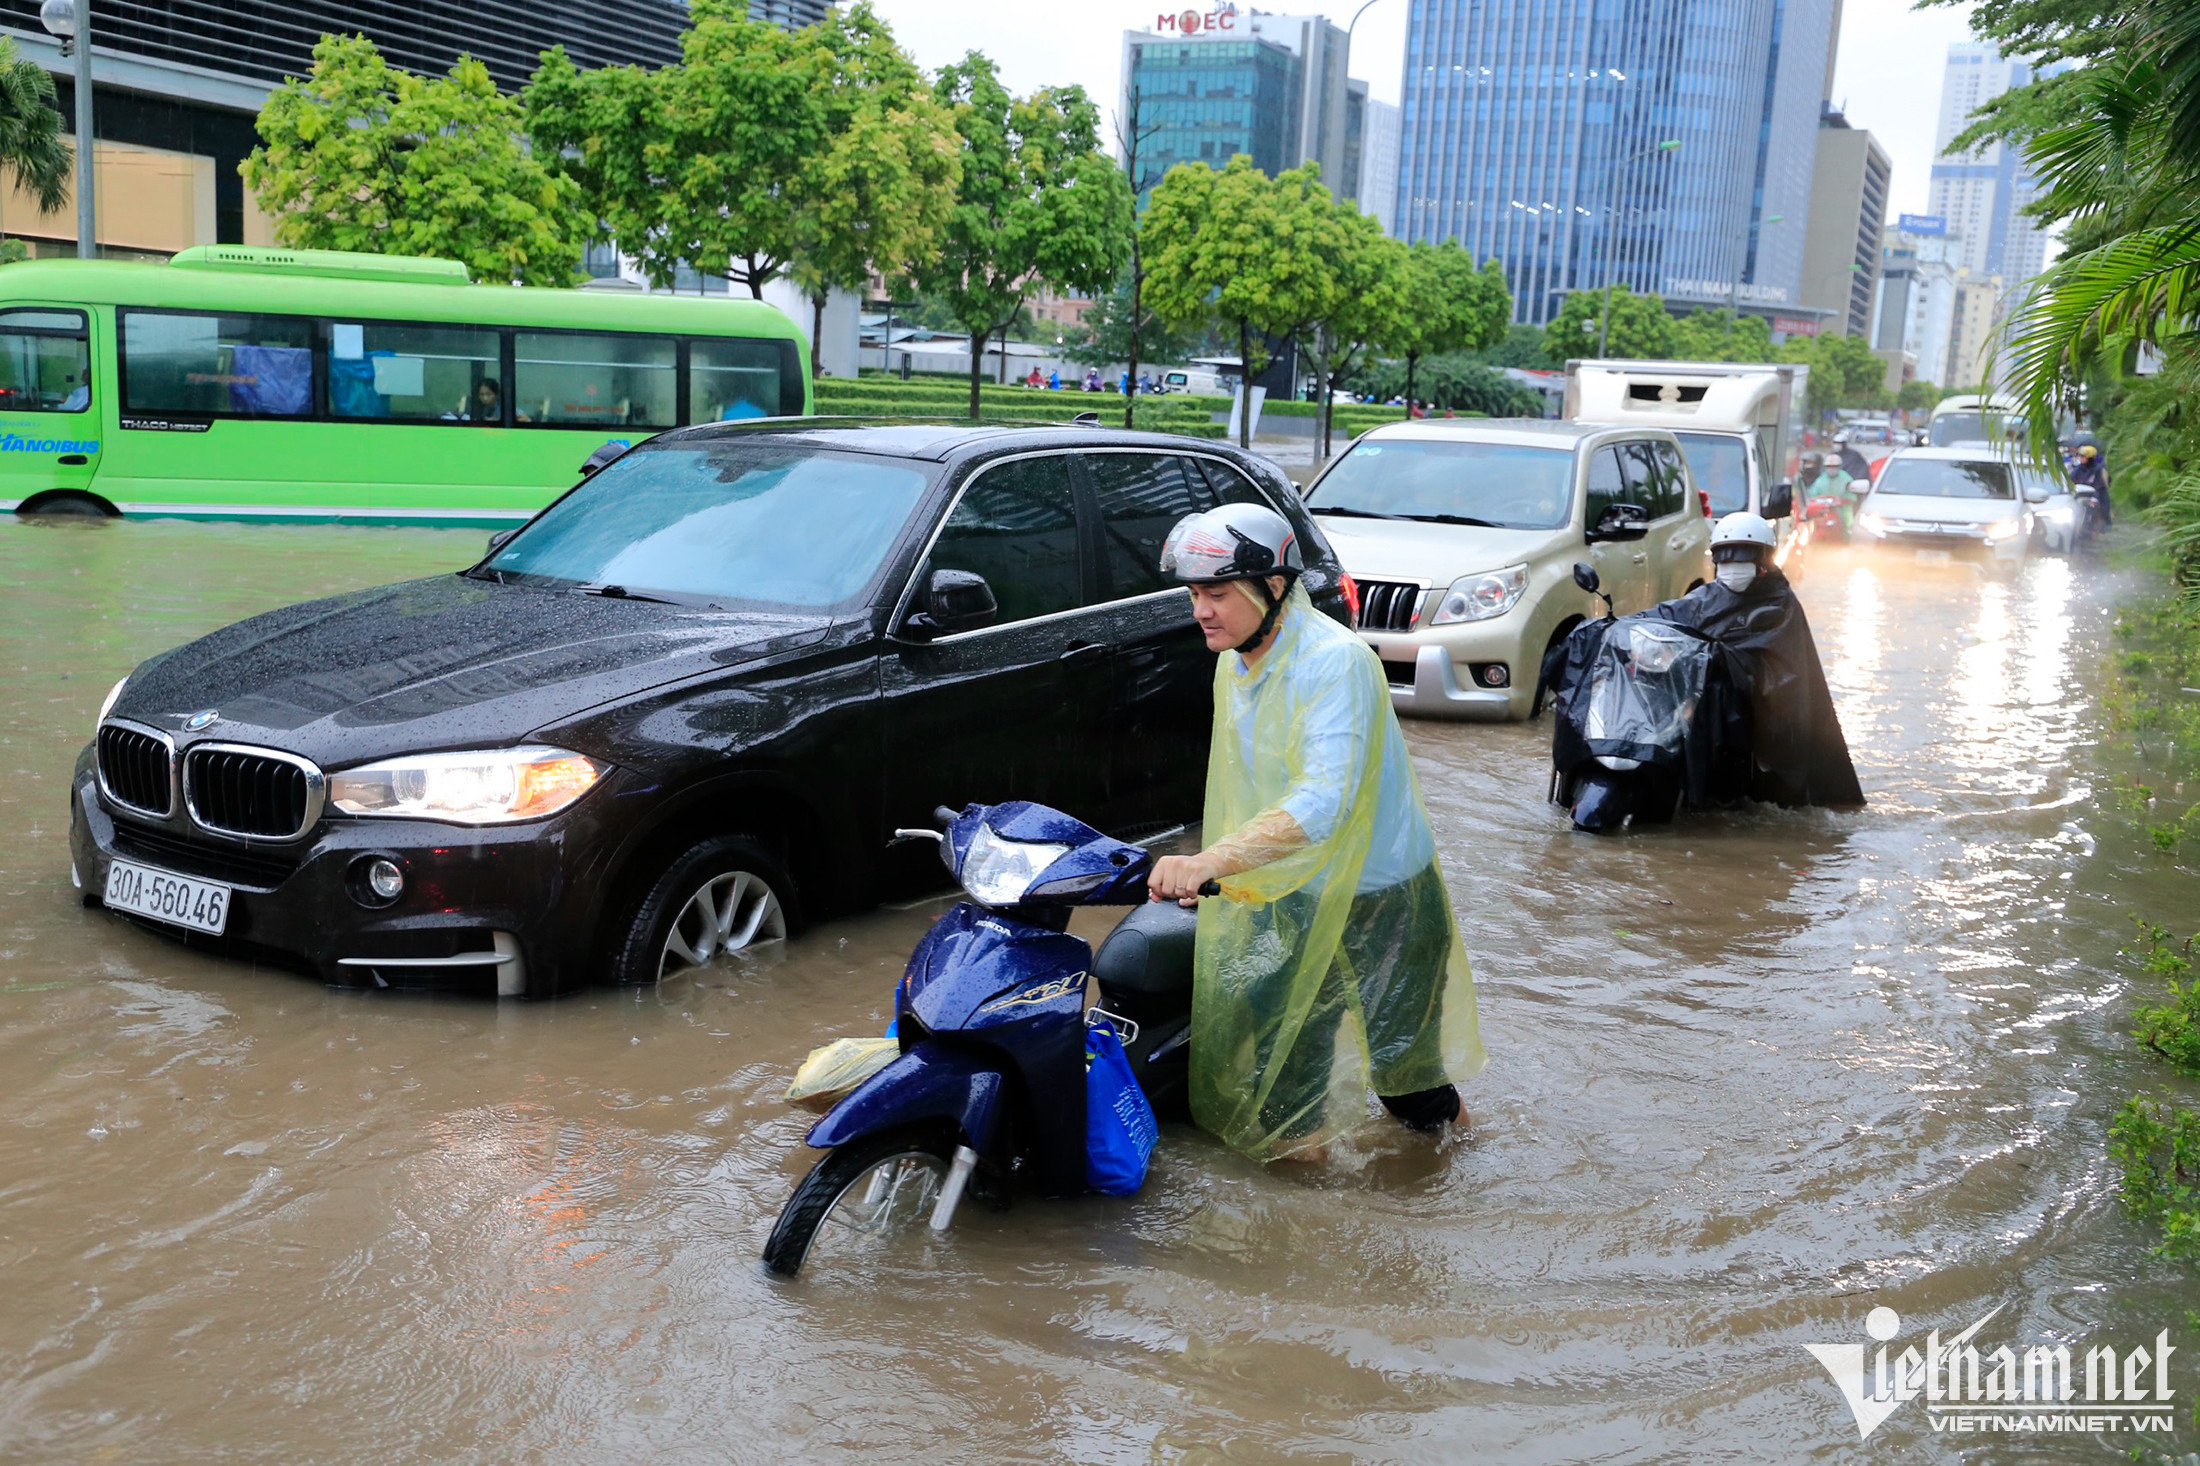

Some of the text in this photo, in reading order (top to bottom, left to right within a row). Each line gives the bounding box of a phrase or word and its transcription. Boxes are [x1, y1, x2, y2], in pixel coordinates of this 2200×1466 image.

[1702, 281, 1734, 296] NAM
[121, 419, 168, 430] THACO
[109, 866, 223, 927] 30A-560.46
[975, 919, 1012, 937] HONDA
